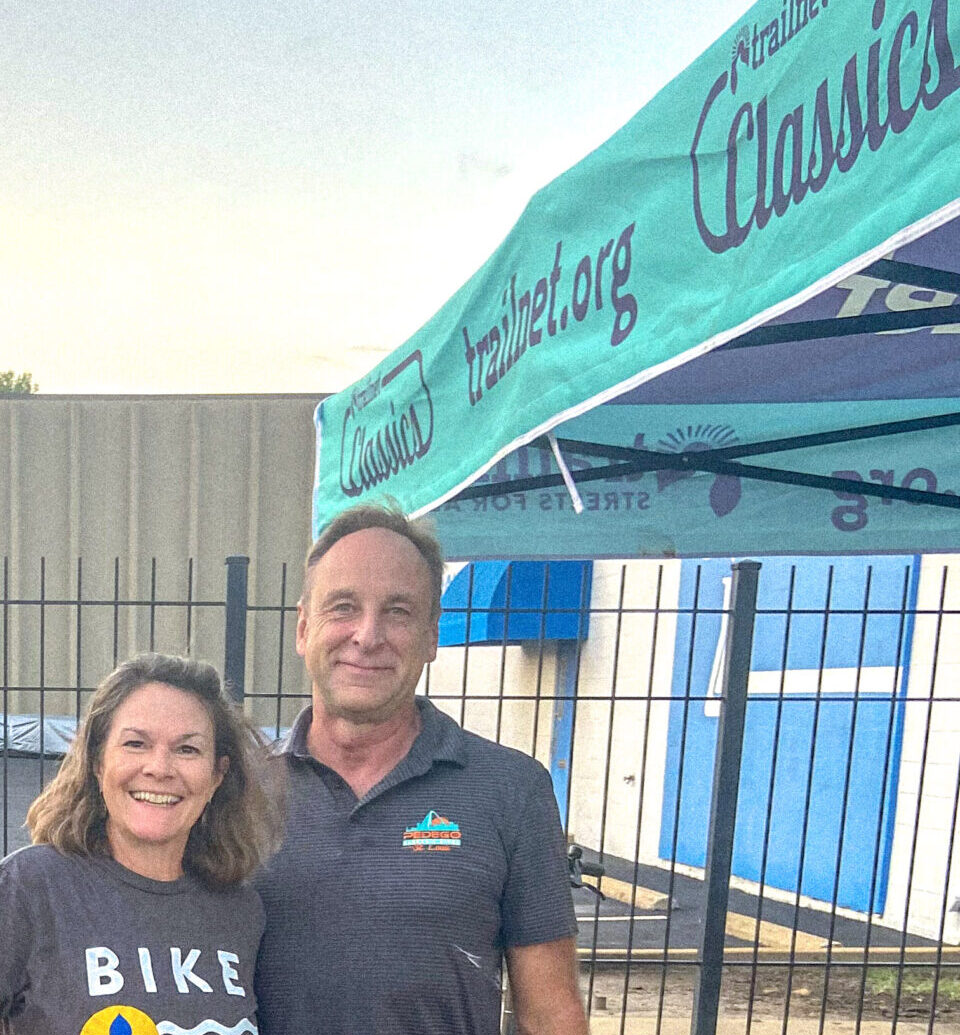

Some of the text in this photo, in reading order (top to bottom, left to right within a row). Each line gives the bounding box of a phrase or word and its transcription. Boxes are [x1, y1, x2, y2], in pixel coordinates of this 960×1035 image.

[751, 0, 828, 70] trailne
[690, 0, 960, 254] Classics
[462, 220, 638, 406] trailnet.org
[341, 400, 428, 498] Classics
[403, 831, 462, 840] PEDEGO
[85, 947, 246, 998] BIKE
